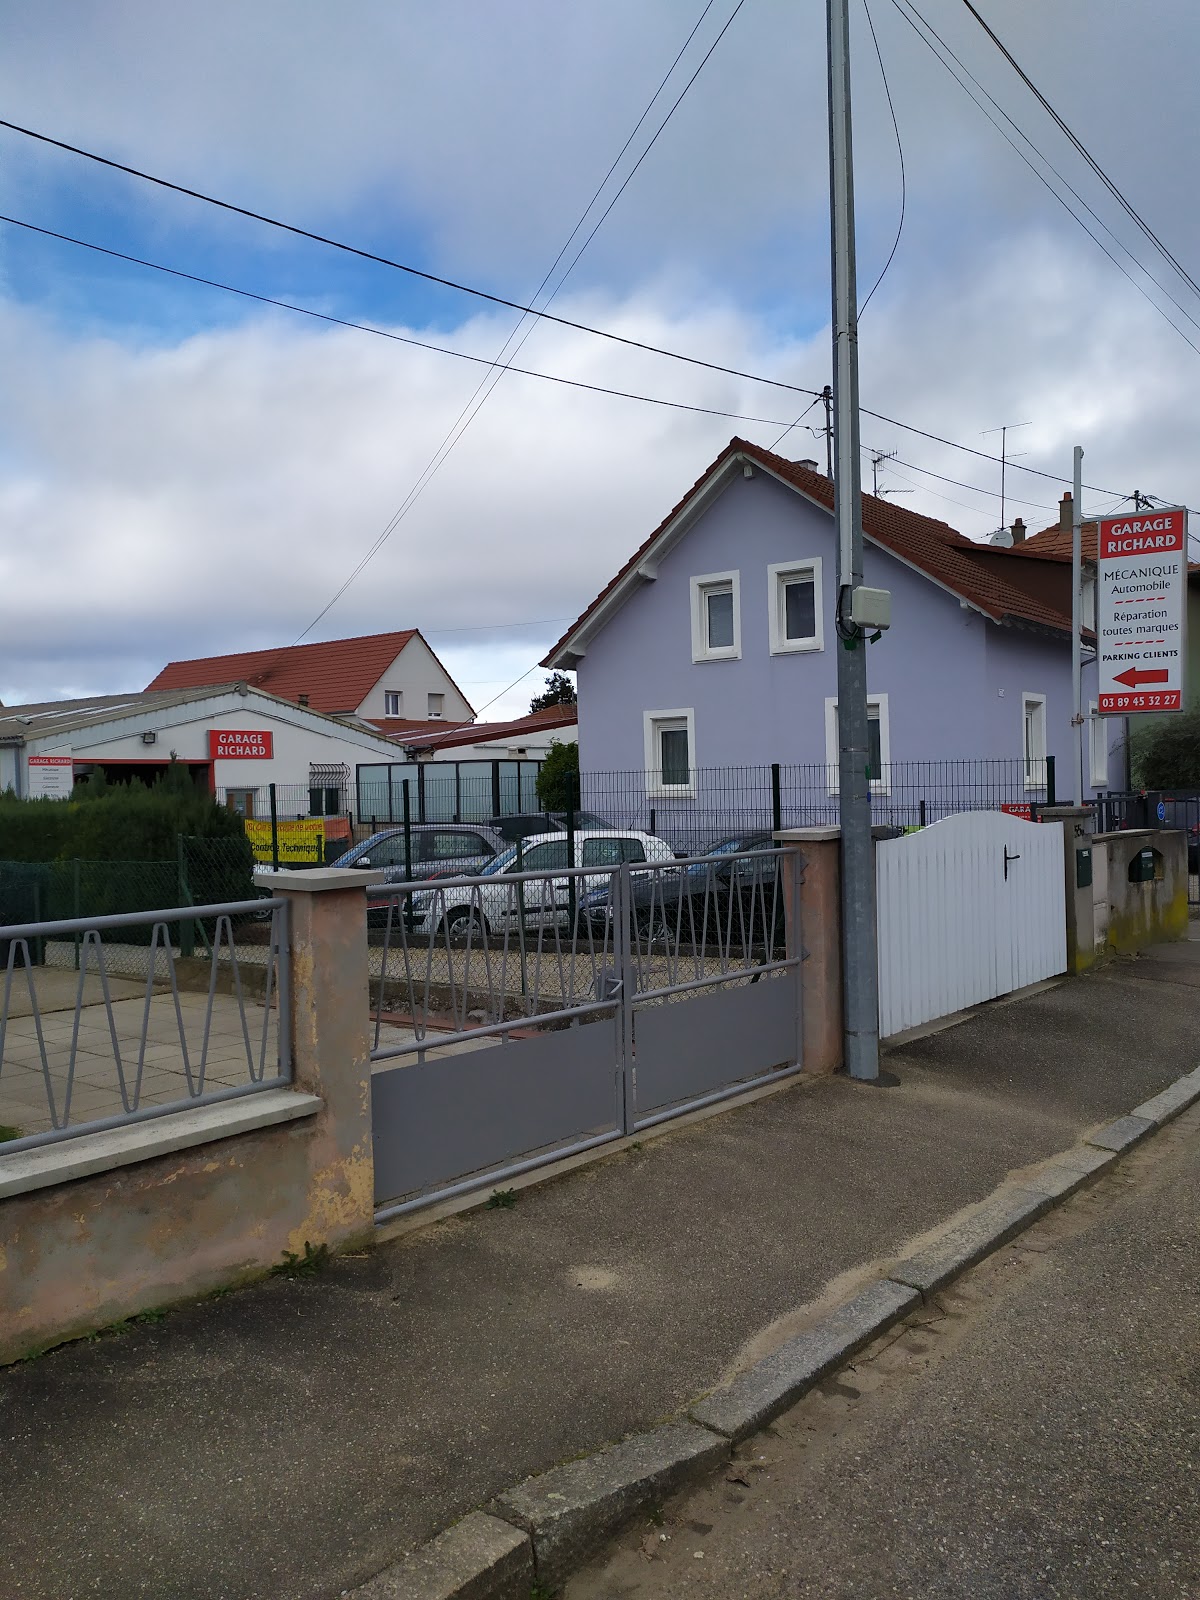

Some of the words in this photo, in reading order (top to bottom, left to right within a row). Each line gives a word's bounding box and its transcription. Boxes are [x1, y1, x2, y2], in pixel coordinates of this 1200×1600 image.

[1111, 517, 1173, 536] GARAGE
[1107, 534, 1177, 553] RICHARD
[1104, 564, 1179, 582] MÉCANIQUE
[1111, 580, 1171, 595] Automobile
[1113, 609, 1168, 622] Réparation
[1102, 627, 1133, 637] toutes
[1136, 623, 1179, 634] marques
[1102, 652, 1140, 662] PARKING
[1143, 649, 1179, 659] CLIENTS
[1102, 697, 1114, 708] 03
[1117, 697, 1130, 707] 89
[1132, 696, 1145, 706] 45
[1148, 696, 1161, 706] 32
[1164, 695, 1177, 705] 27
[219, 734, 263, 744] GARAGE
[217, 745, 266, 755] RICHARD
